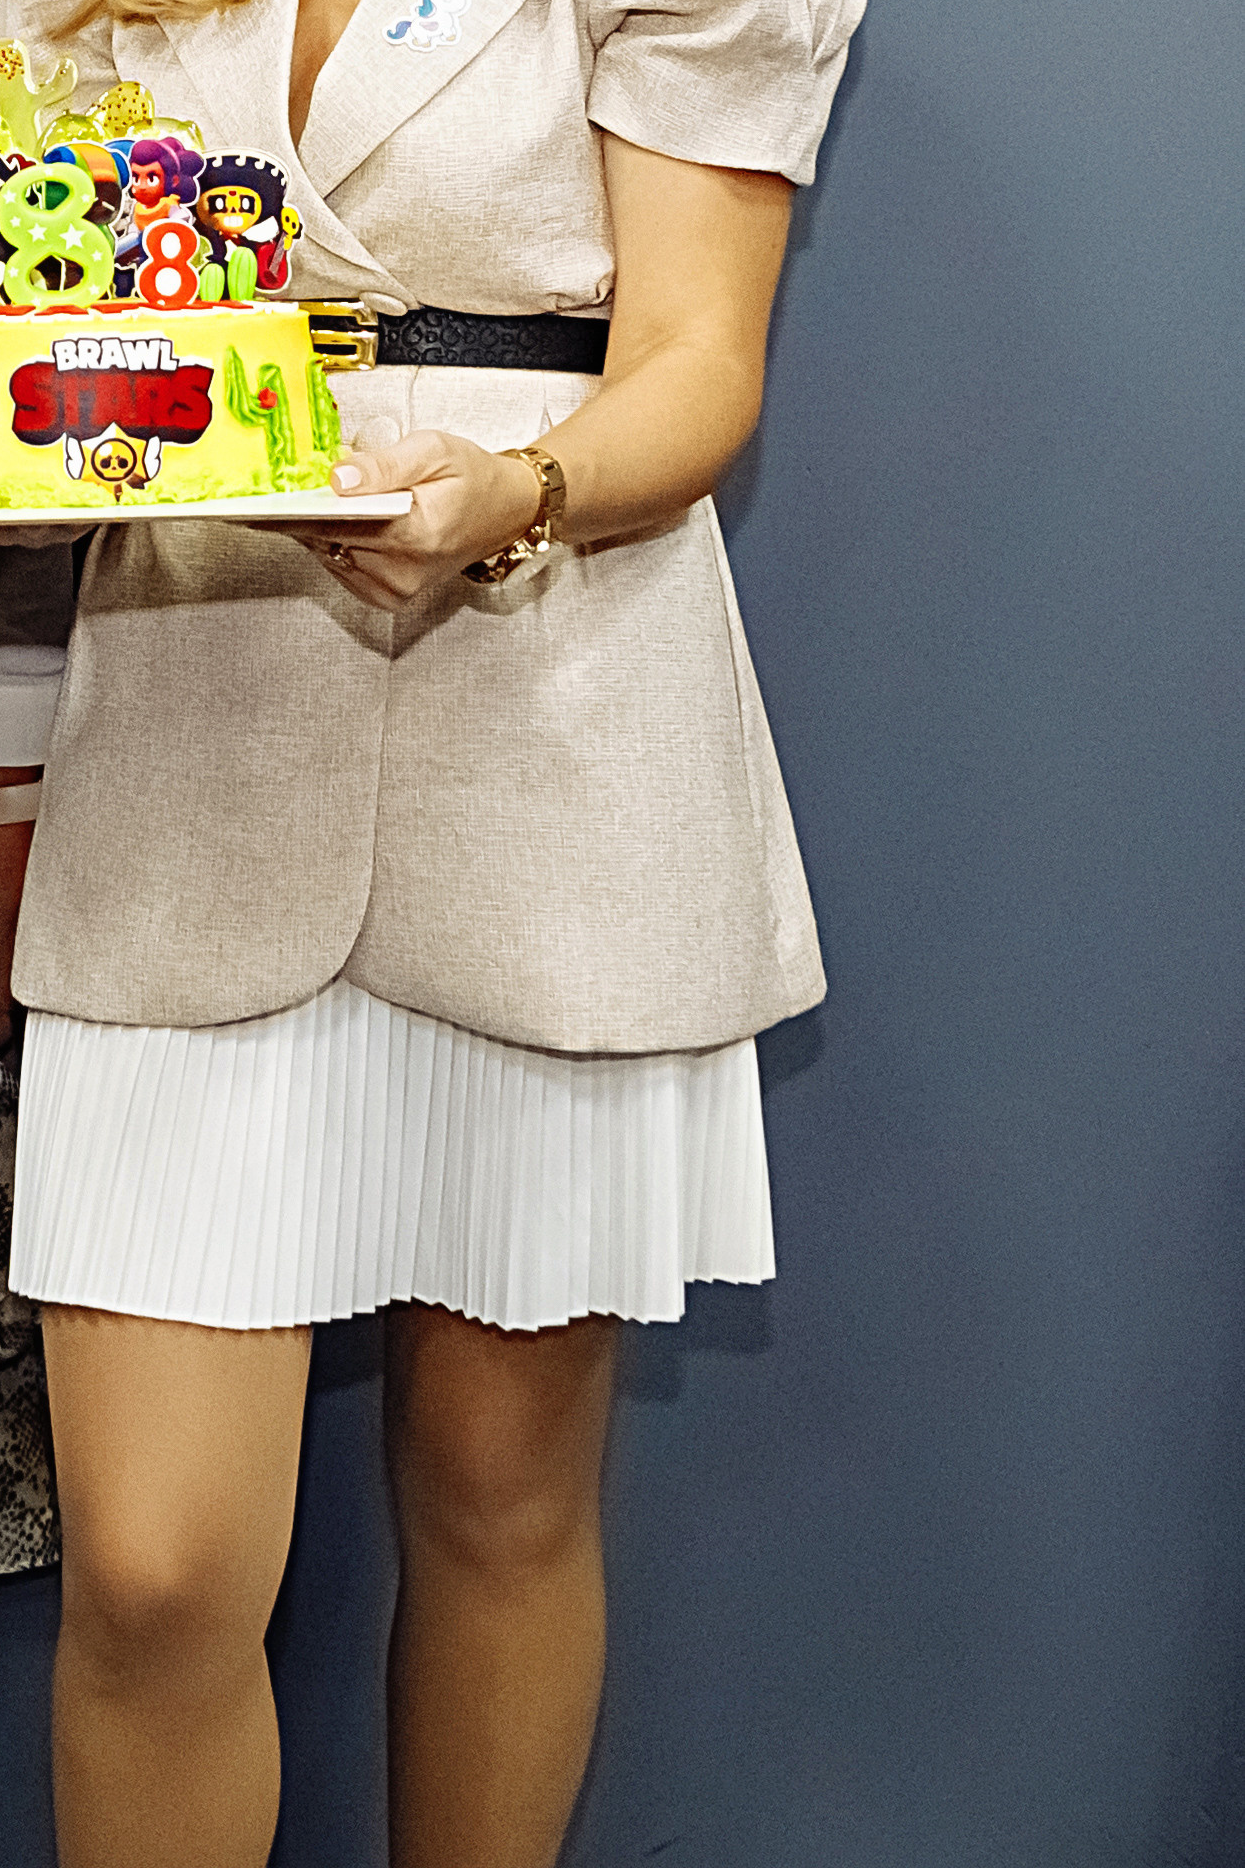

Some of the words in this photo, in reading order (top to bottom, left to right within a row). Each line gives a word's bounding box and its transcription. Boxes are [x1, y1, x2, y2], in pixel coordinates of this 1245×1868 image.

[138, 221, 199, 308] 8
[53, 337, 180, 372] BRAWL
[10, 362, 214, 436] STARS
